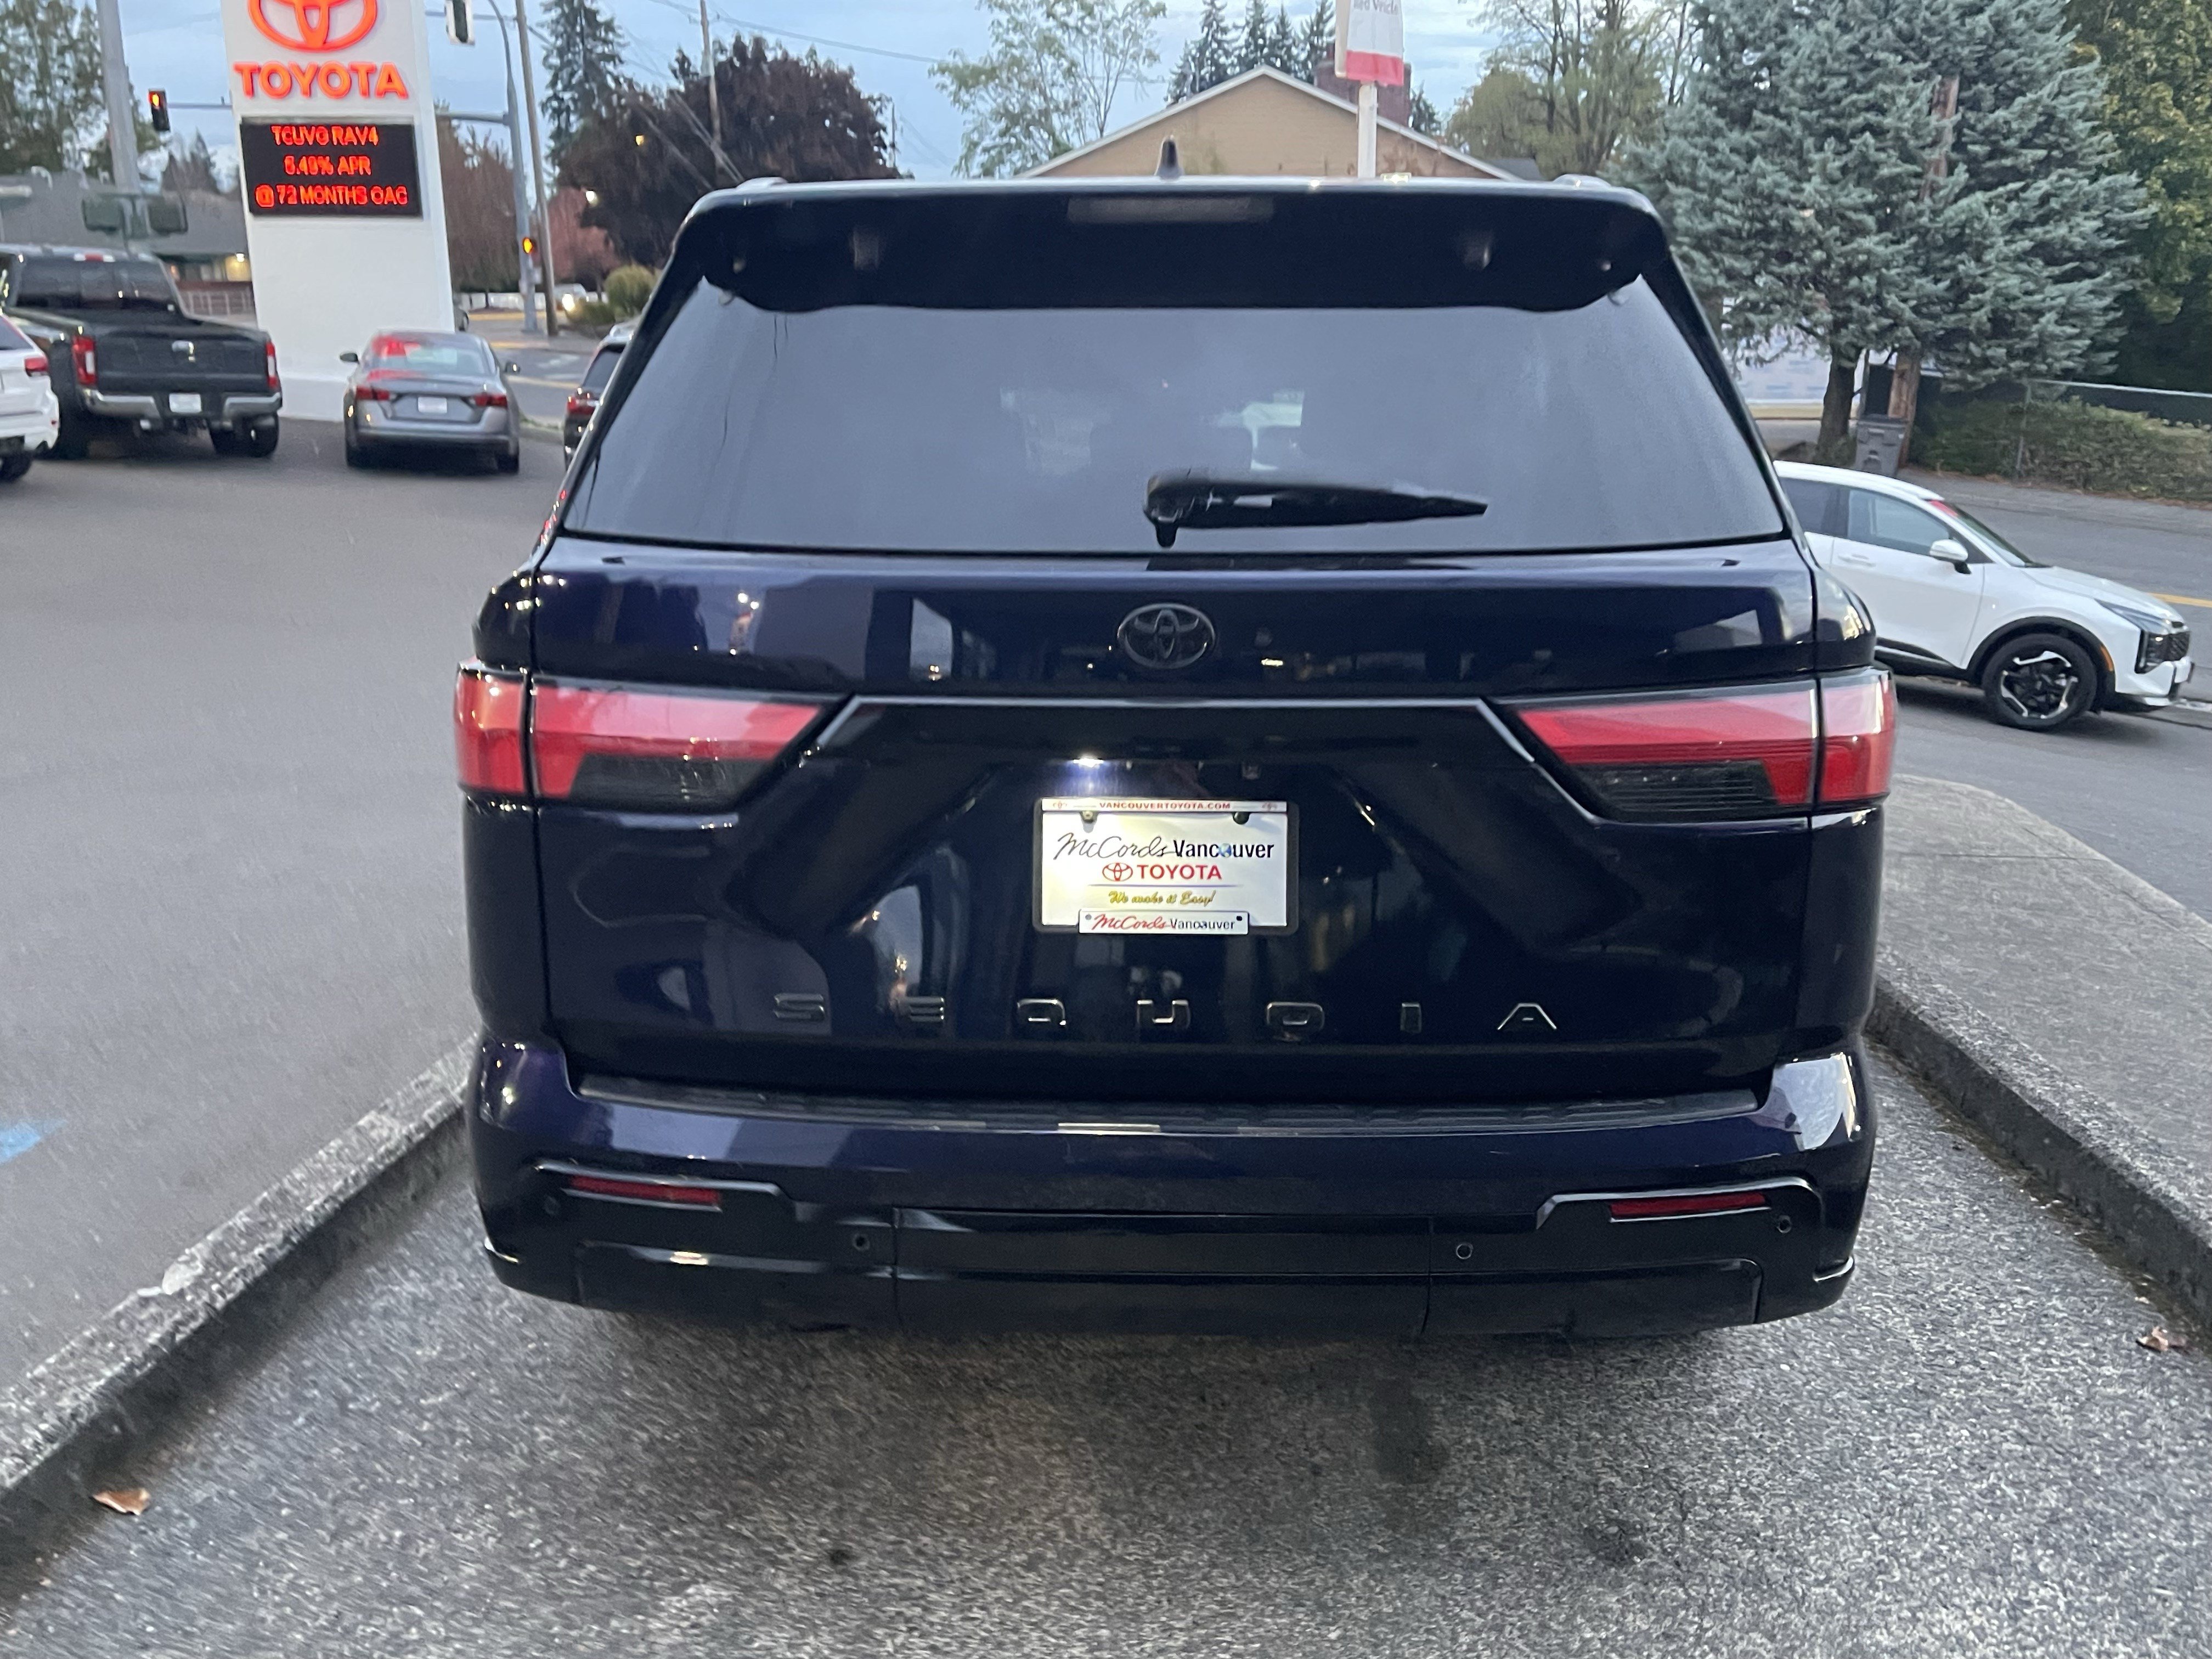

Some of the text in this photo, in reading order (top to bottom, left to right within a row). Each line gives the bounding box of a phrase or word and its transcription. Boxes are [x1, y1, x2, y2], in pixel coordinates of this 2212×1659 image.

[234, 61, 408, 99] TOYOTA
[330, 125, 380, 146] RAV4
[336, 155, 372, 176] APR
[255, 184, 408, 207] @ 72 MONTHS OAC
[1099, 802, 1231, 810] VANCOUVERTOYOTA.COM
[1052, 832, 1275, 861] McCords Vancouver
[1136, 864, 1222, 881] TOYOTA
[1109, 890, 1128, 904] We
[1132, 891, 1163, 904] make
[1180, 890, 1217, 907] Easy!
[1091, 913, 1235, 930] McCords Vancouver
